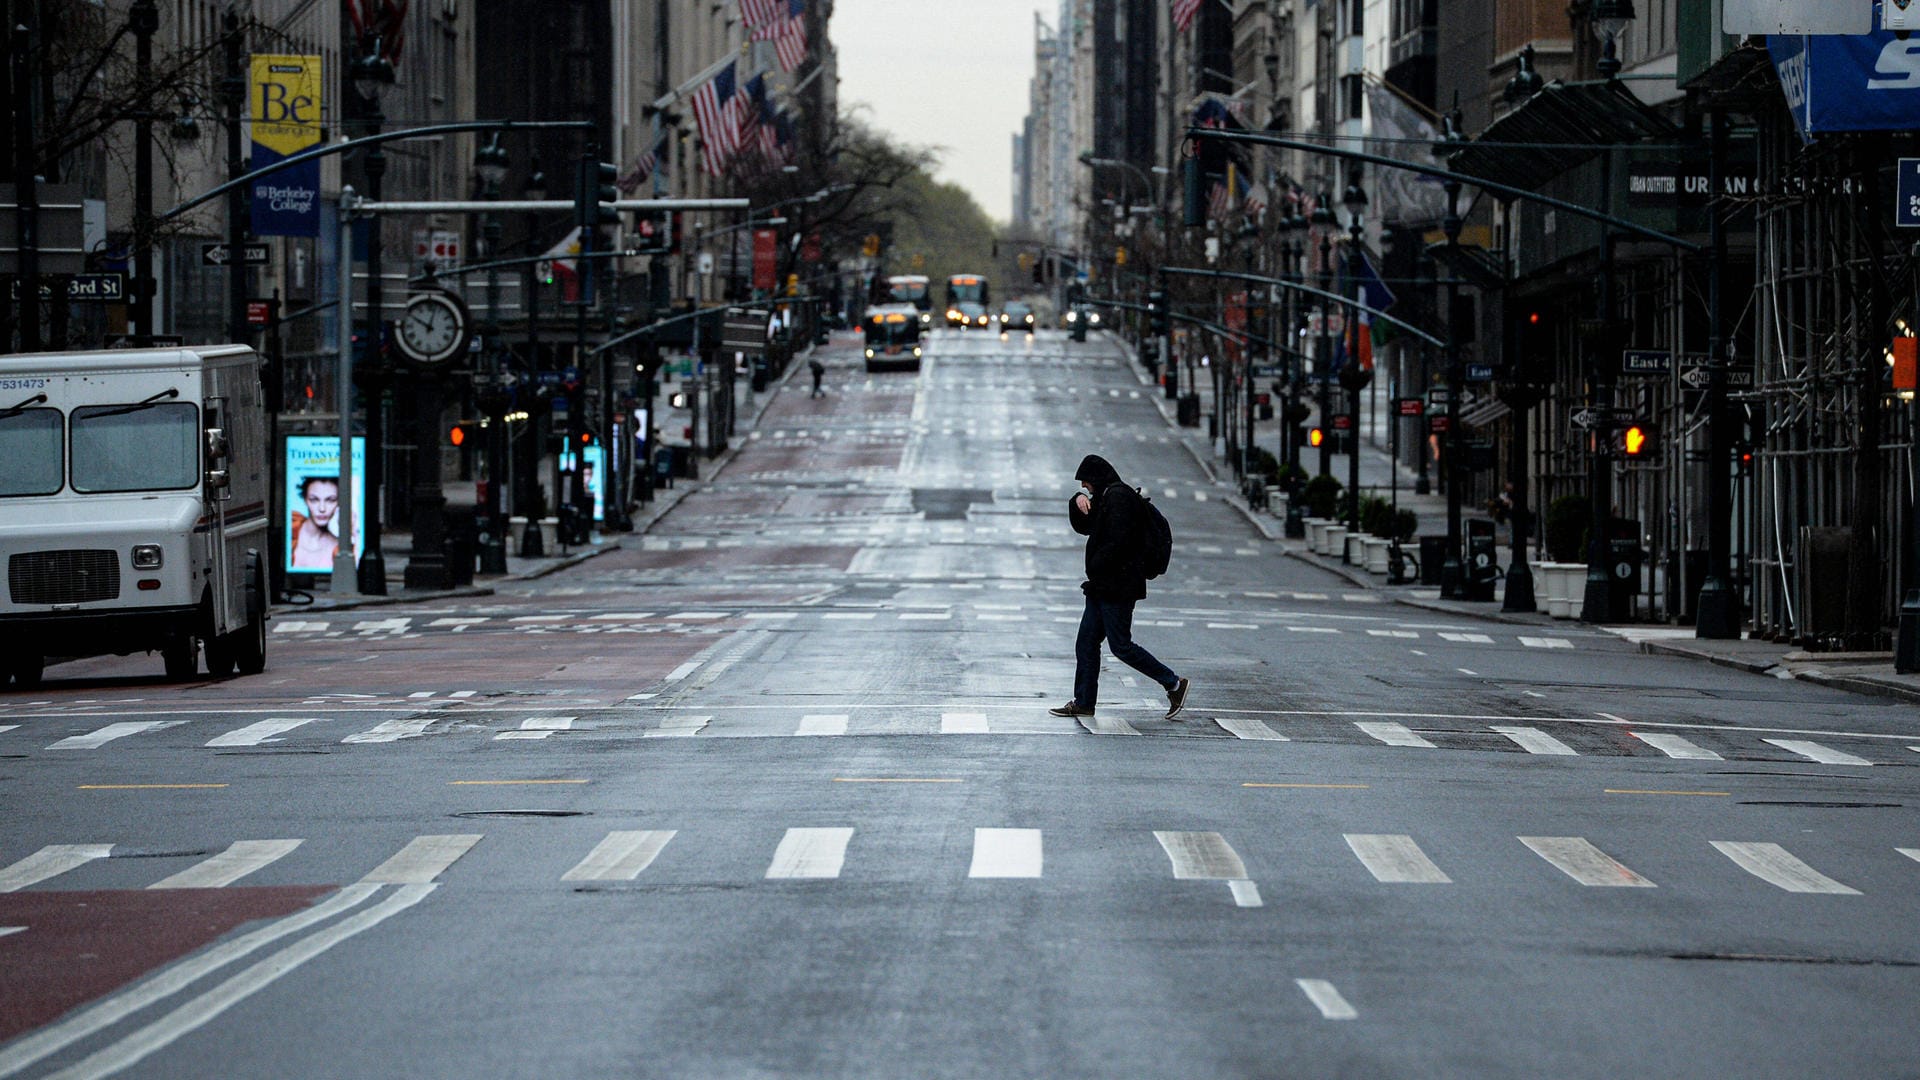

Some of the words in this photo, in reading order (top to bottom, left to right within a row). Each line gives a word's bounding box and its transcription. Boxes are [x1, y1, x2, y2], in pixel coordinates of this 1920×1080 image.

[258, 82, 313, 123] Be
[1684, 175, 1747, 194] URAN
[268, 186, 315, 201] Berkeley
[270, 200, 312, 214] College
[102, 279, 118, 294] St
[1630, 355, 1659, 369] East
[1471, 367, 1492, 377] East
[1690, 371, 1710, 382] ONE
